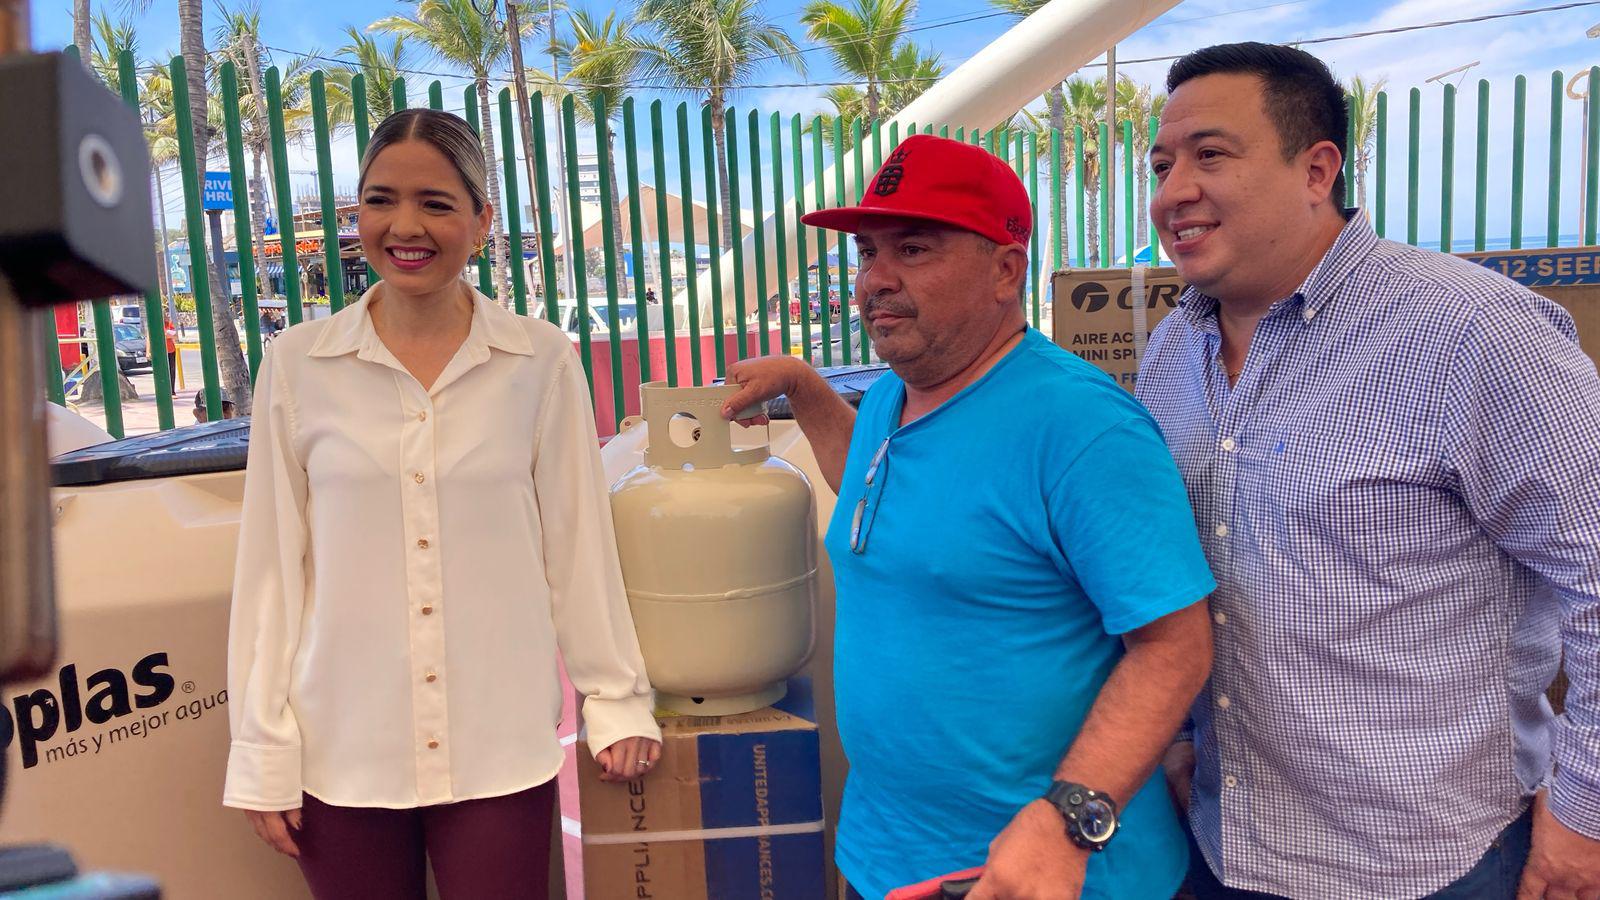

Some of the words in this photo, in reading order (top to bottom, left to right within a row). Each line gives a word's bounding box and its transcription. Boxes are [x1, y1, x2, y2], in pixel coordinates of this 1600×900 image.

[1117, 283, 1193, 310] GR
[1072, 333, 1108, 345] AIRE
[1073, 349, 1108, 361] MINI
[46, 738, 88, 763] más
[92, 733, 102, 754] y
[109, 710, 170, 743] mejor
[175, 690, 228, 719] agua
